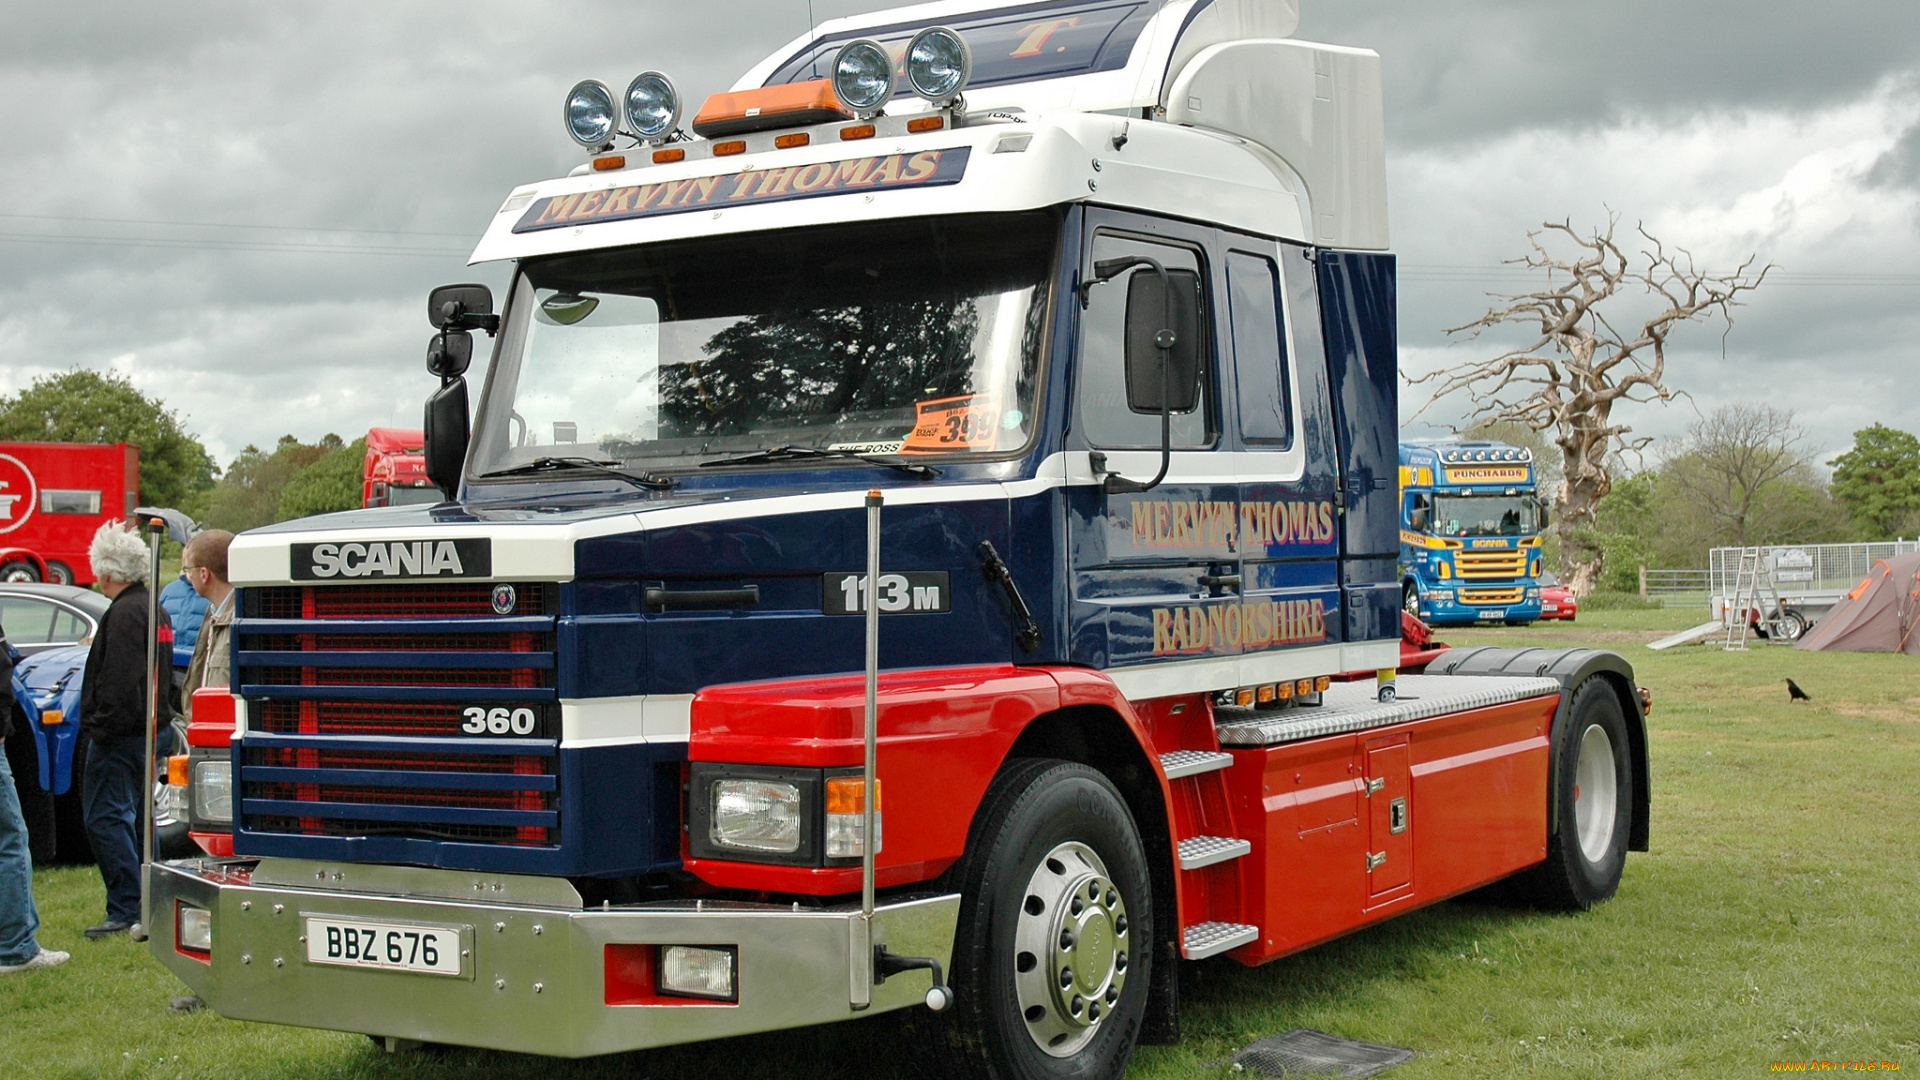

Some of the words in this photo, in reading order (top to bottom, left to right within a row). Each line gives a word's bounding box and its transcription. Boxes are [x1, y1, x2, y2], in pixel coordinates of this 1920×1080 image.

[534, 174, 720, 225] MERVYN
[729, 150, 941, 199] THOMAS
[940, 410, 996, 442] 399
[865, 444, 900, 452] BOSS
[1453, 469, 1522, 478] PUNCHARDS
[1131, 501, 1238, 548] MERVYN
[1240, 501, 1335, 546] THOMAS
[311, 541, 464, 578] SCANIA
[1152, 599, 1326, 656] RADNORSHIRE
[462, 707, 535, 735] 360
[326, 926, 378, 961] BBZ
[386, 931, 438, 966] 676
